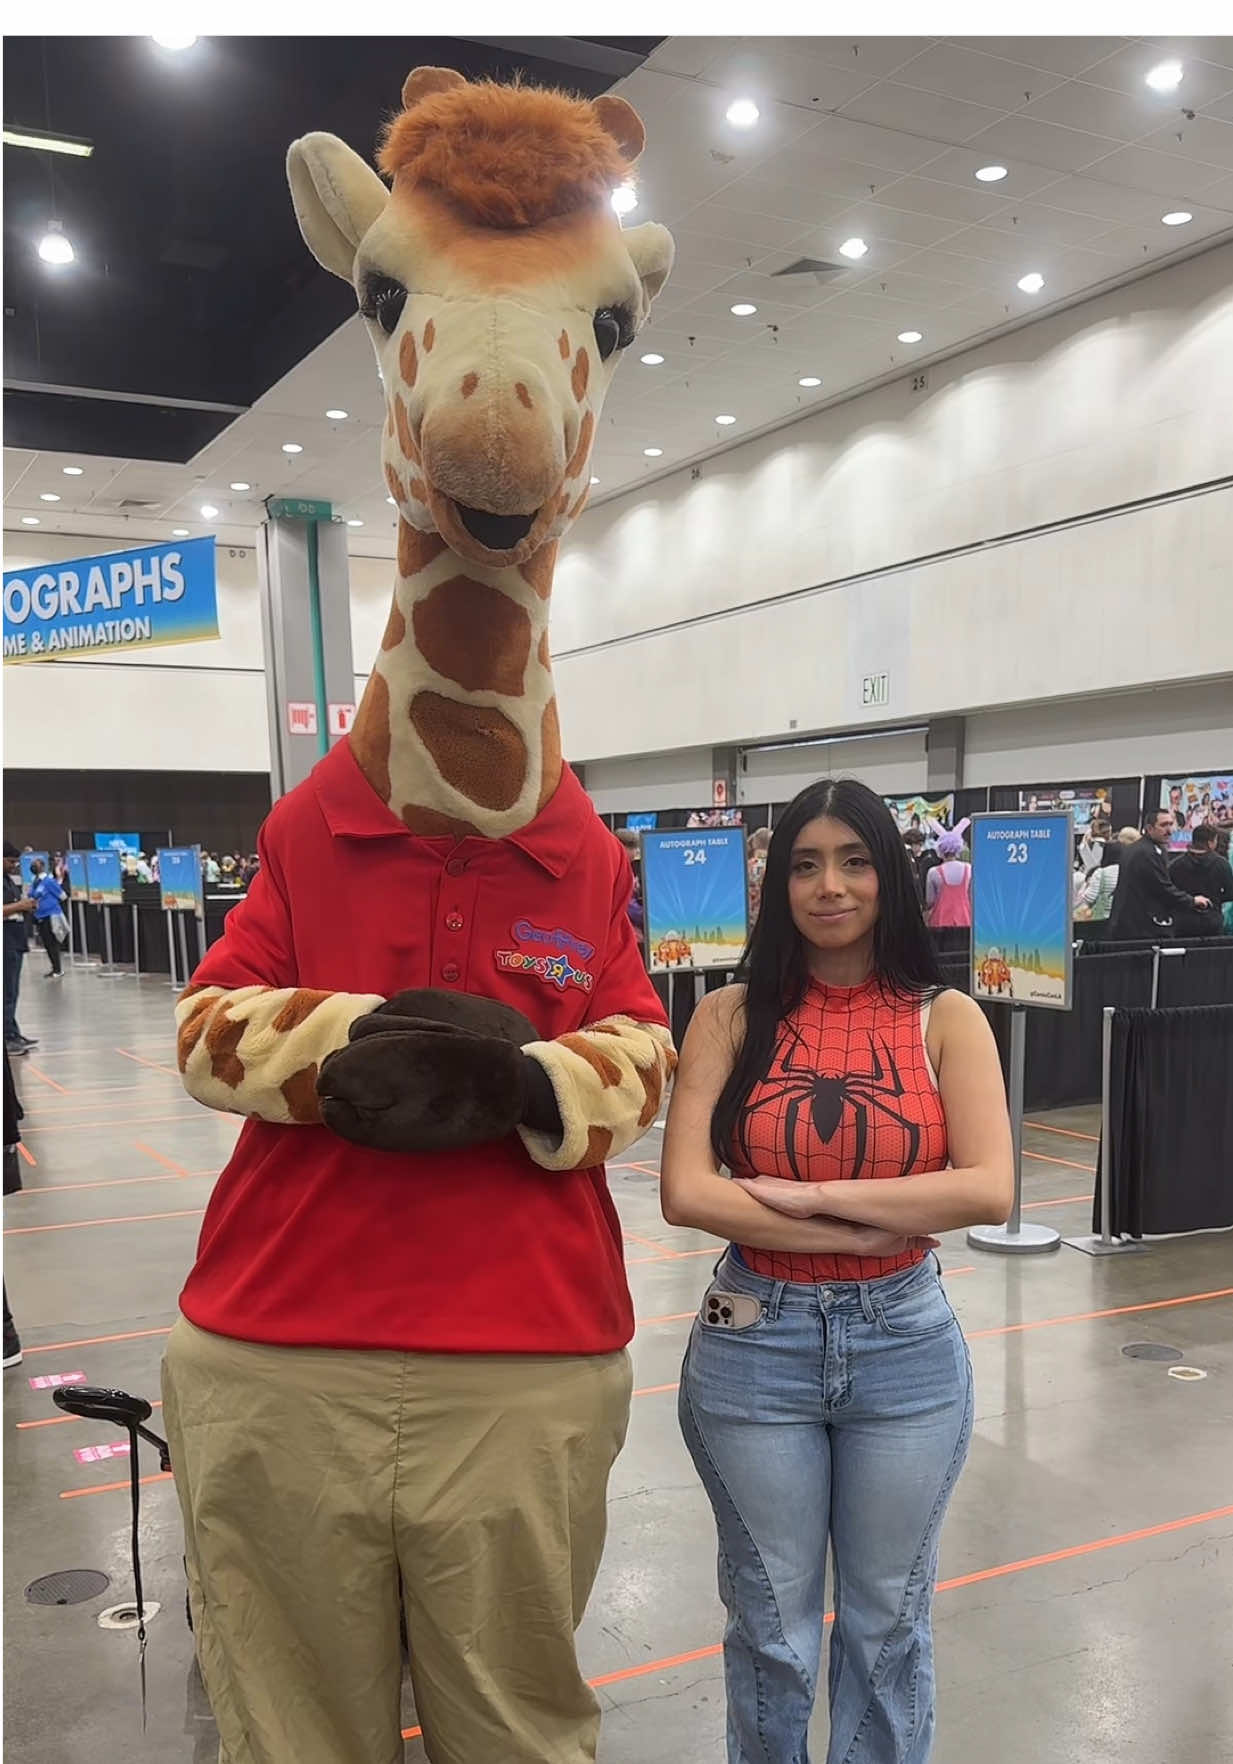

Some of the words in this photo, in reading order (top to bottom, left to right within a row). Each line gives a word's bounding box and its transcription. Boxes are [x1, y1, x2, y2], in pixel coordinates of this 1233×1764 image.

[32, 631, 46, 653] &
[50, 616, 152, 650] ANIMATION
[863, 675, 887, 703] EXIT
[987, 830, 1029, 840] AUTOGRAPH
[1031, 829, 1050, 839] TABLE
[660, 839, 706, 849] AUTOGRAPH
[708, 838, 728, 846] TABLE
[684, 850, 707, 865] 24
[1007, 843, 1028, 863] 23
